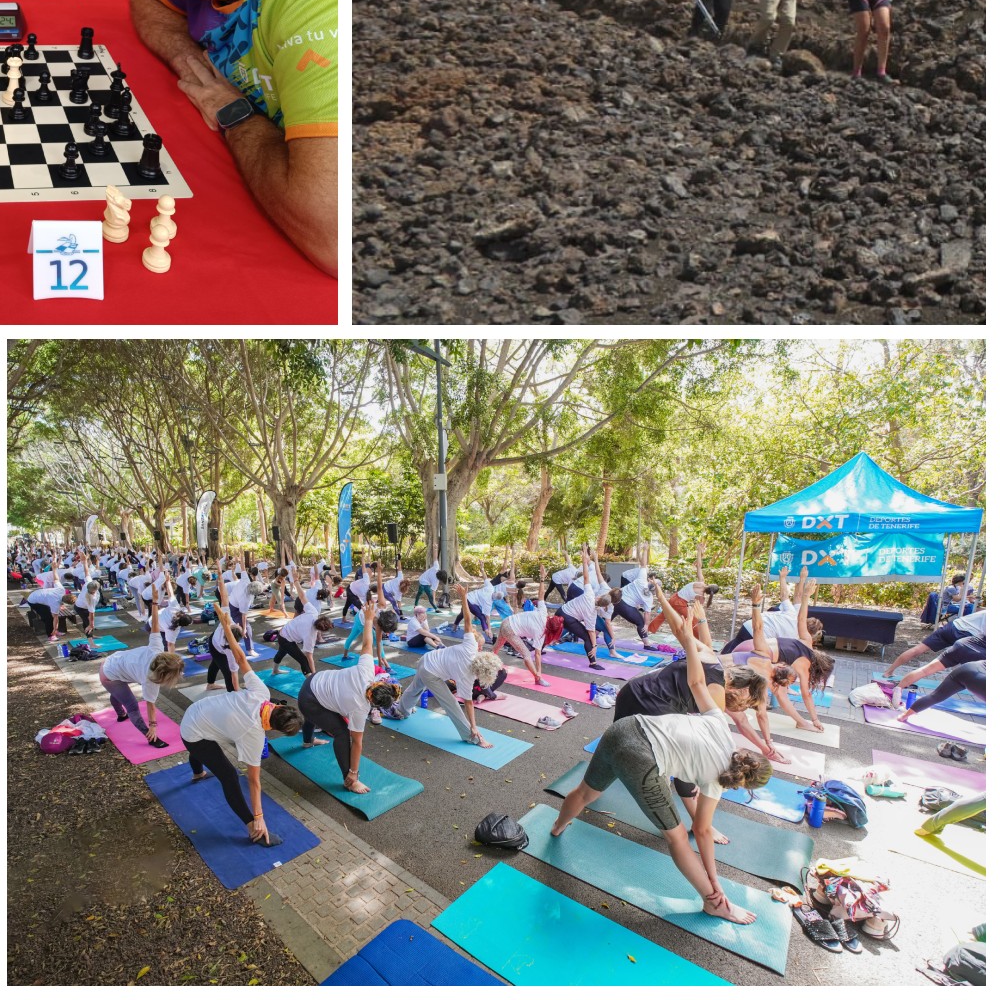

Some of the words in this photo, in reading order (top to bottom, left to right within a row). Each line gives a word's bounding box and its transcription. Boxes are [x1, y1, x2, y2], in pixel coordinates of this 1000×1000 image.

[307, 29, 324, 42] tu
[50, 259, 89, 291] 12
[801, 514, 850, 529] DXT
[801, 549, 838, 566] DX
